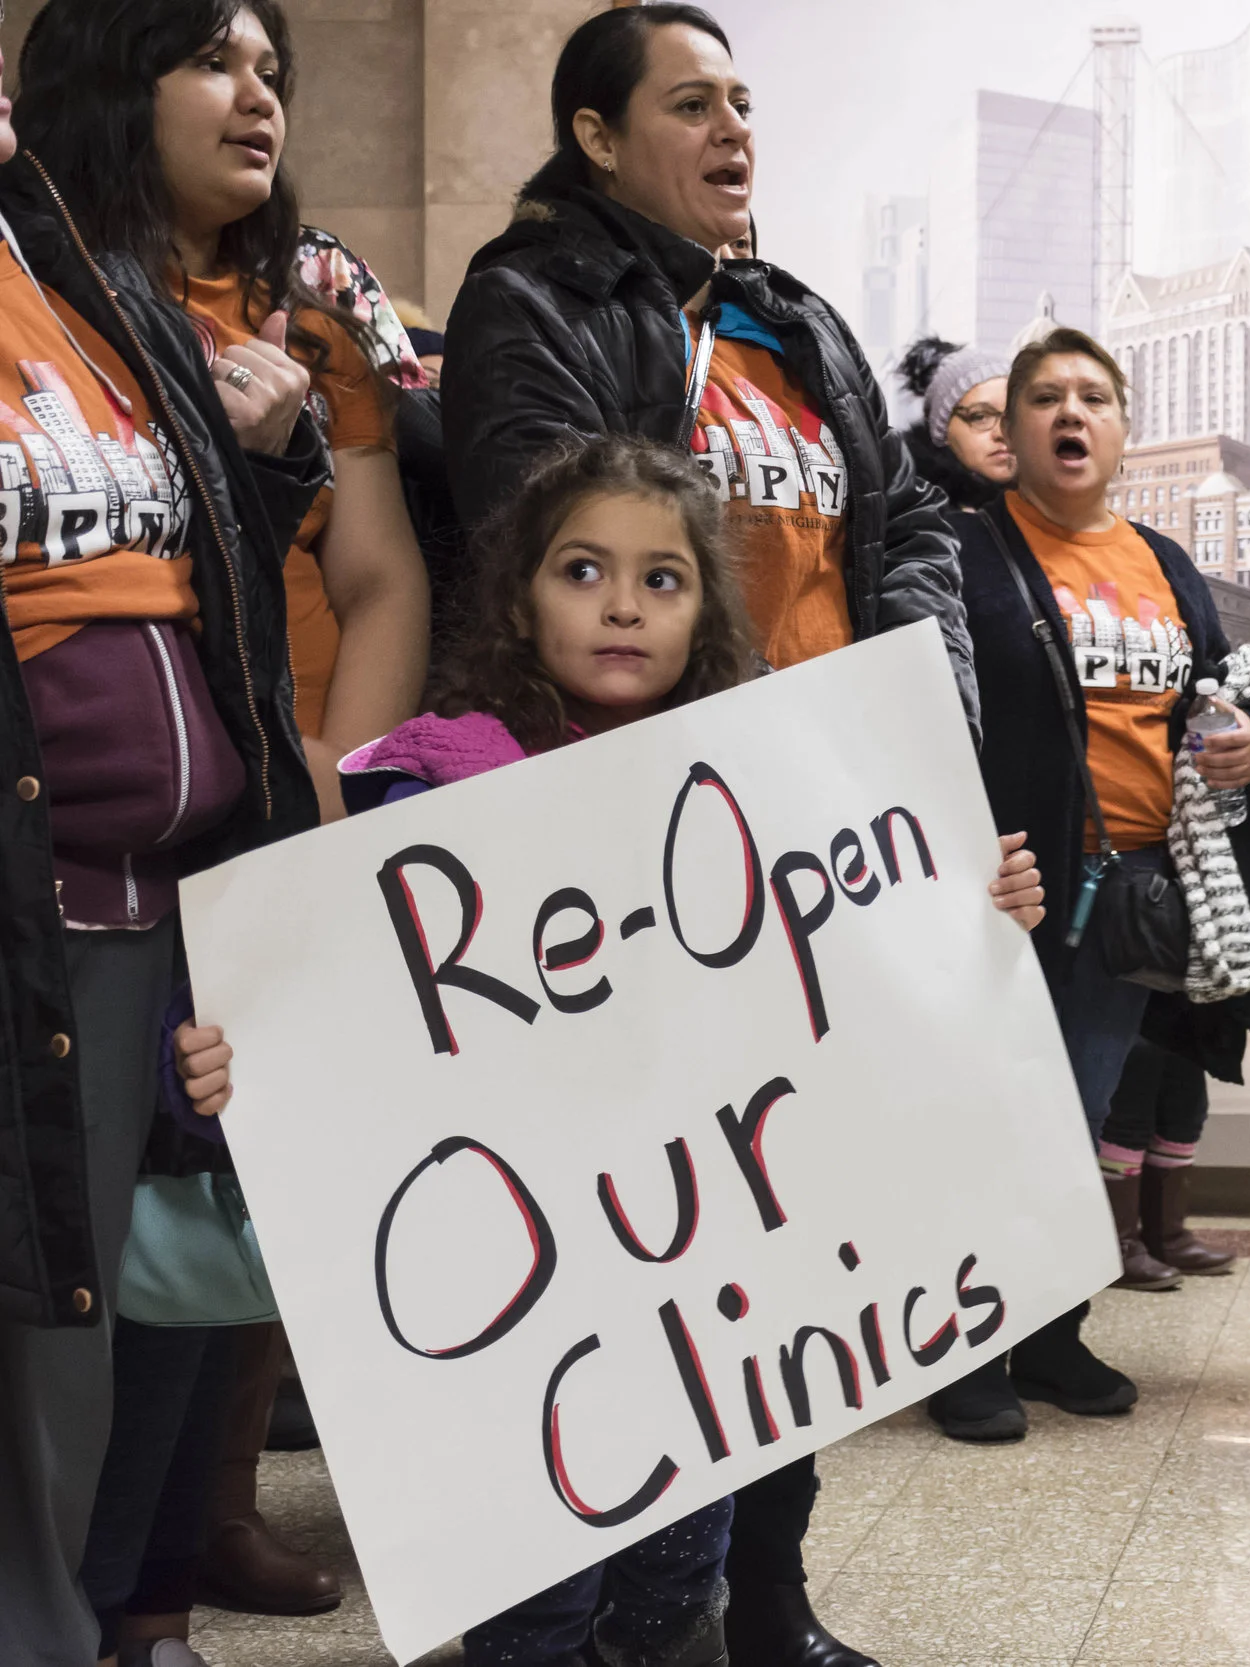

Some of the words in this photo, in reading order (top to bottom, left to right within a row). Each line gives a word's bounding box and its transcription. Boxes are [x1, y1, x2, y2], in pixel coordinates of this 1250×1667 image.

[376, 761, 939, 1057] Re-Open
[374, 1076, 798, 1361] Our
[541, 1240, 1007, 1529] Clinics
